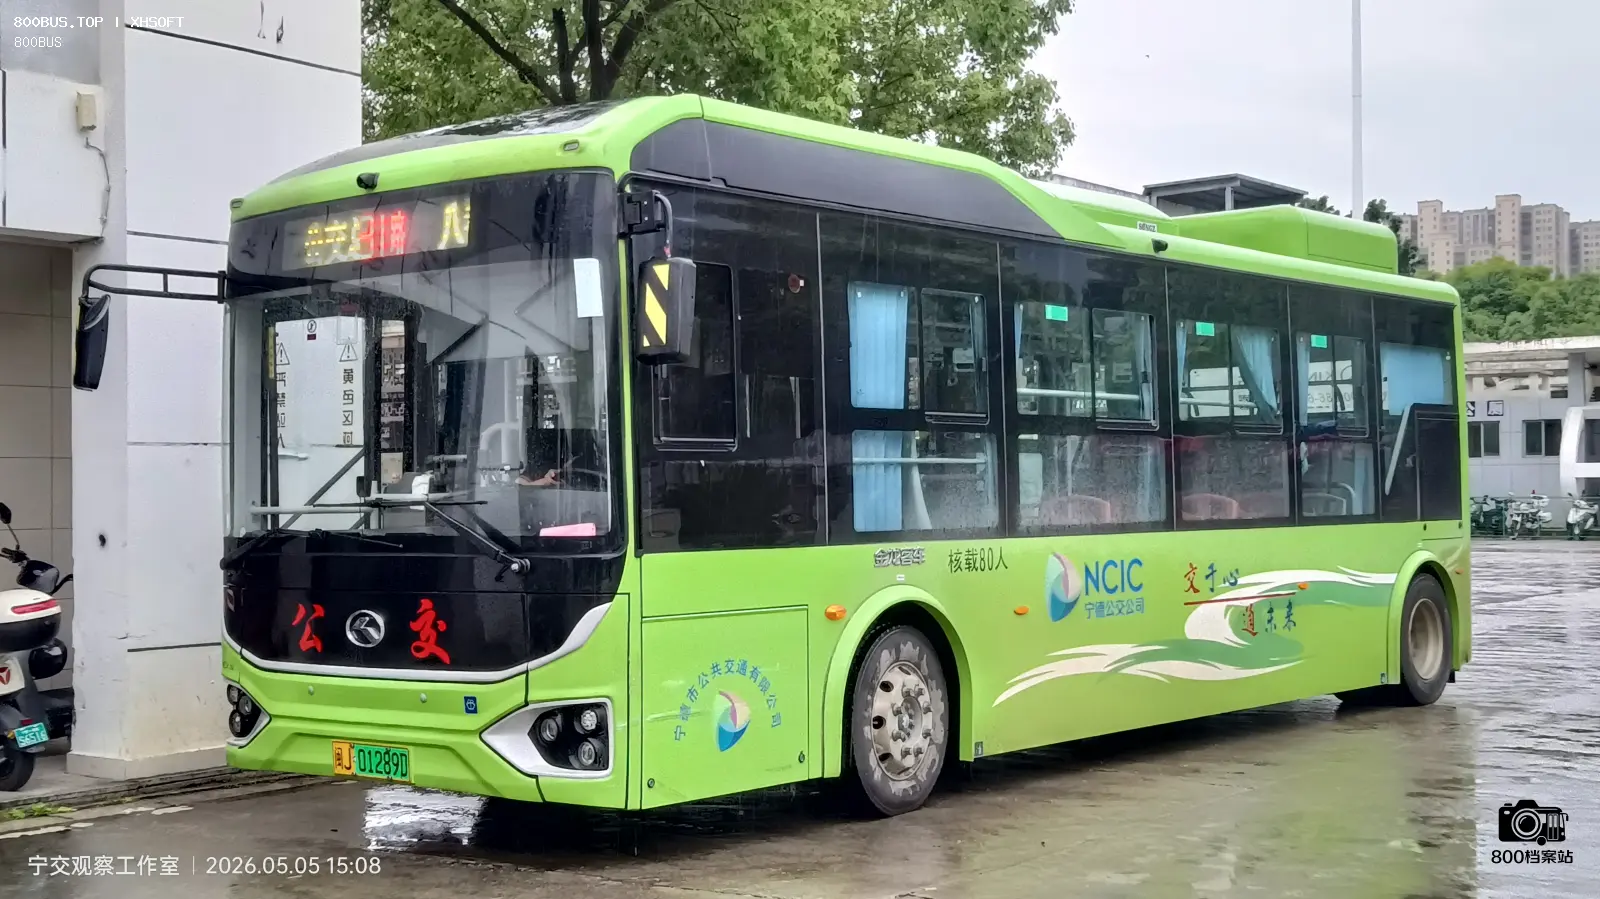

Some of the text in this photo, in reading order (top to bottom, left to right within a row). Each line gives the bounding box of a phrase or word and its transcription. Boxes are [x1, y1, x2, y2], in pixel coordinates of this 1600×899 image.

[873, 546, 925, 568] 金龙客车
[947, 546, 1009, 574] 核载80人
[1084, 557, 1144, 596] NCIC
[1083, 597, 1145, 620] 宁德公交公司
[673, 658, 782, 741] 宁德市公共交通有限公司
